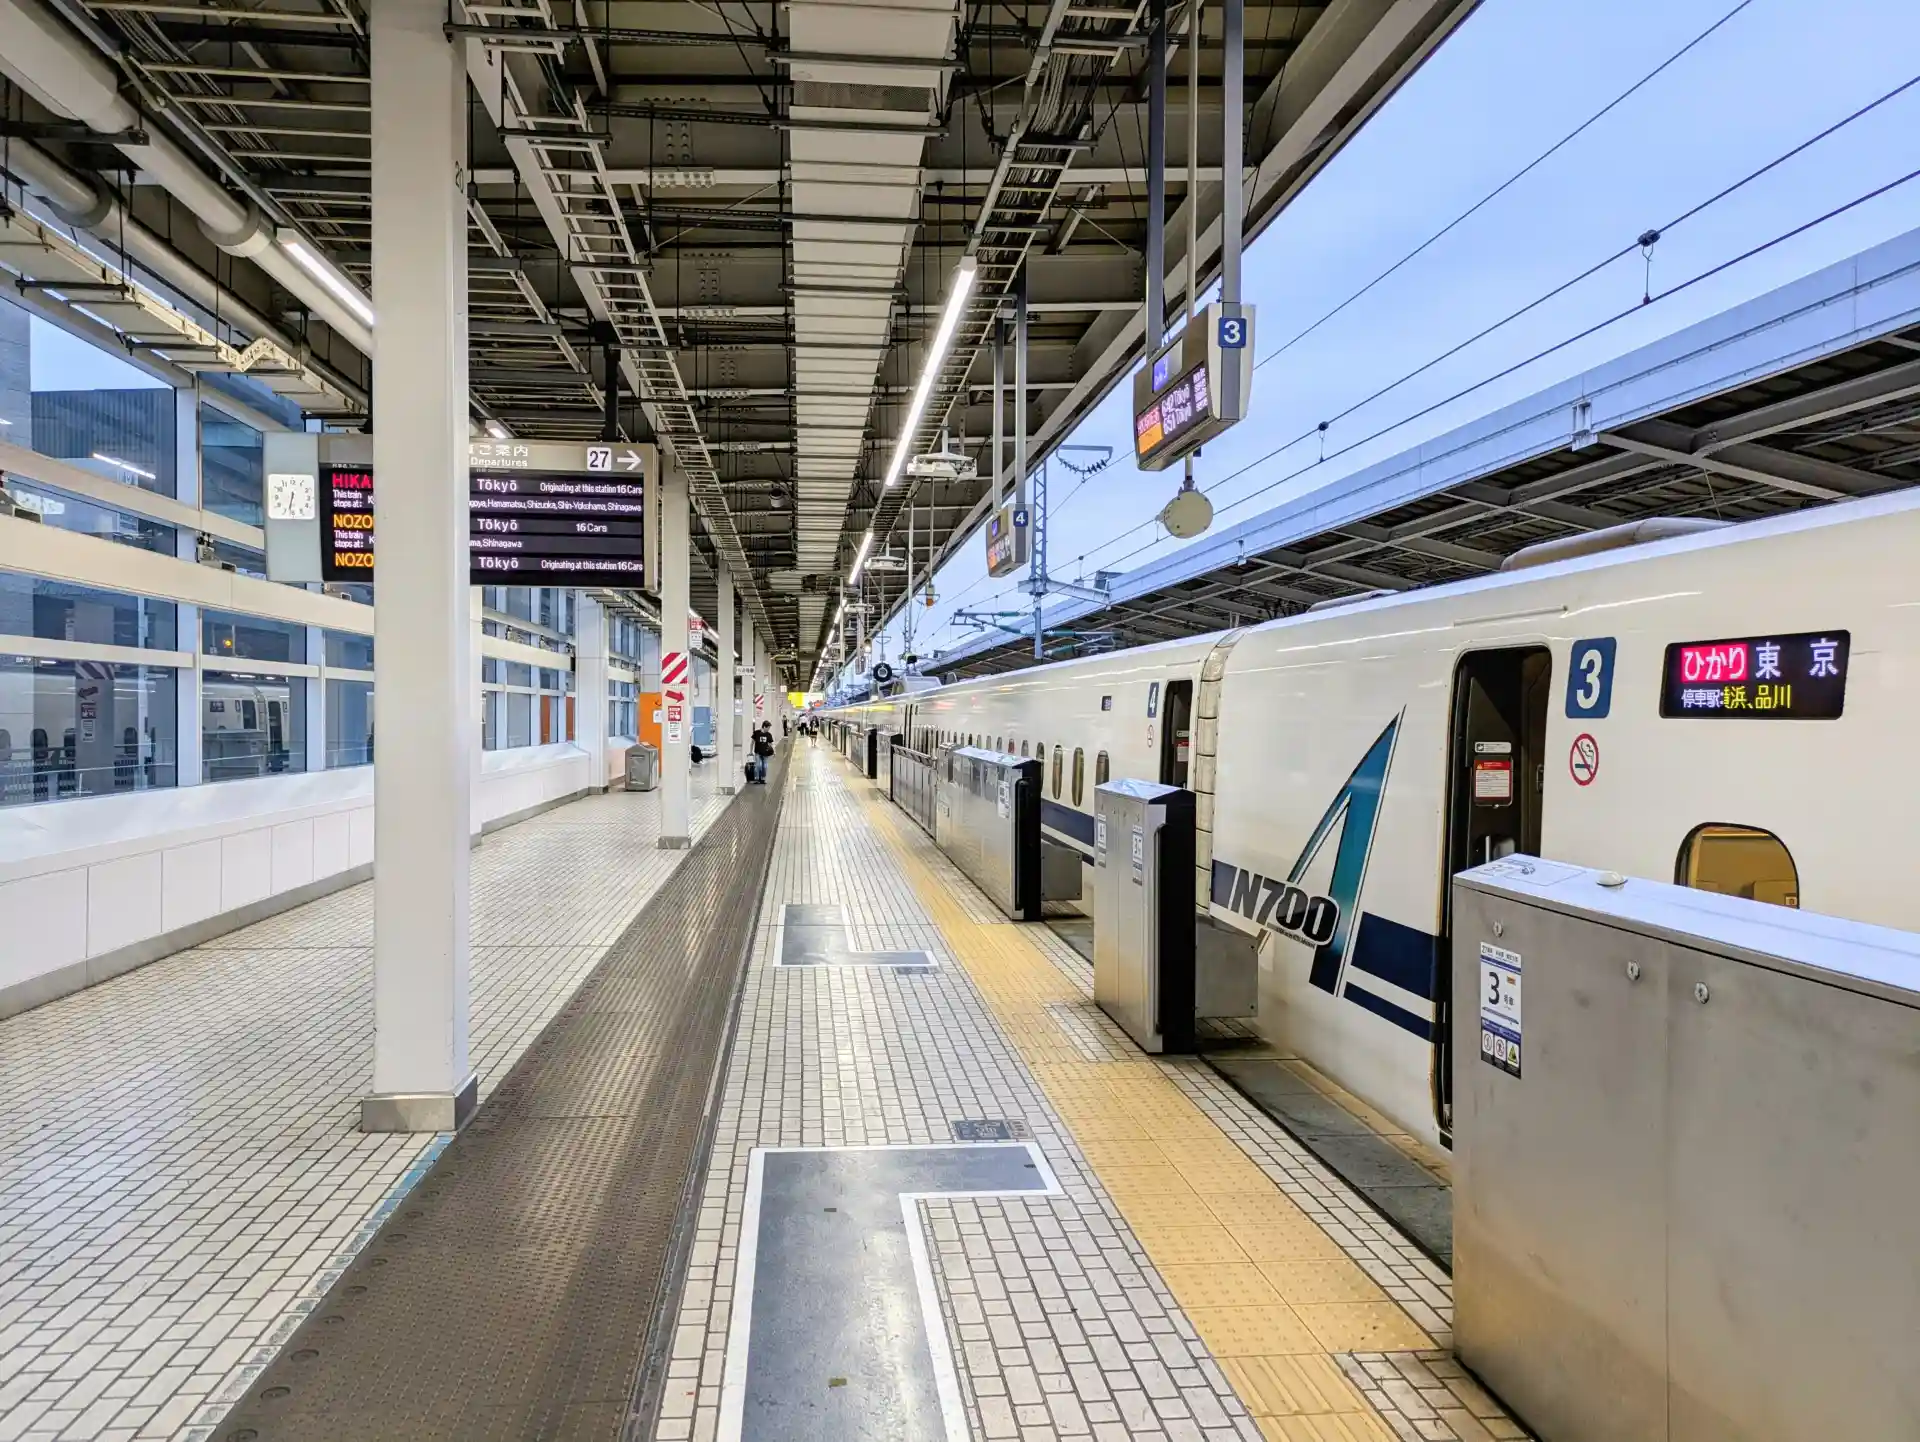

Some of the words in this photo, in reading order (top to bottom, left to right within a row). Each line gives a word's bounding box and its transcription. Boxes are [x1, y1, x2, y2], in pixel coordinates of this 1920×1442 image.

[1223, 320, 1241, 344] 3
[470, 456, 528, 468] Departures
[589, 450, 609, 468] 27
[332, 489, 346, 499] This
[347, 490, 362, 499] train
[540, 482, 574, 494] Originating
[574, 484, 581, 493] at
[581, 484, 594, 493] this
[595, 485, 616, 494] station
[617, 485, 627, 494] 16
[627, 485, 642, 494] Cars
[333, 499, 351, 508] stops
[1016, 512, 1026, 525] 4
[575, 523, 587, 532] 16
[587, 523, 608, 532] Cars
[334, 530, 347, 539] This
[348, 530, 363, 539] train
[334, 540, 352, 548] stops
[541, 560, 575, 571] Originating
[575, 561, 582, 569] at
[582, 561, 595, 570] this
[595, 562, 617, 570] station
[617, 561, 627, 570] 16
[627, 562, 643, 571] Cars
[1684, 646, 1745, 681] ひかり
[1576, 649, 1603, 709] 3
[1149, 686, 1157, 714] 4
[1488, 972, 1500, 1005] 3
